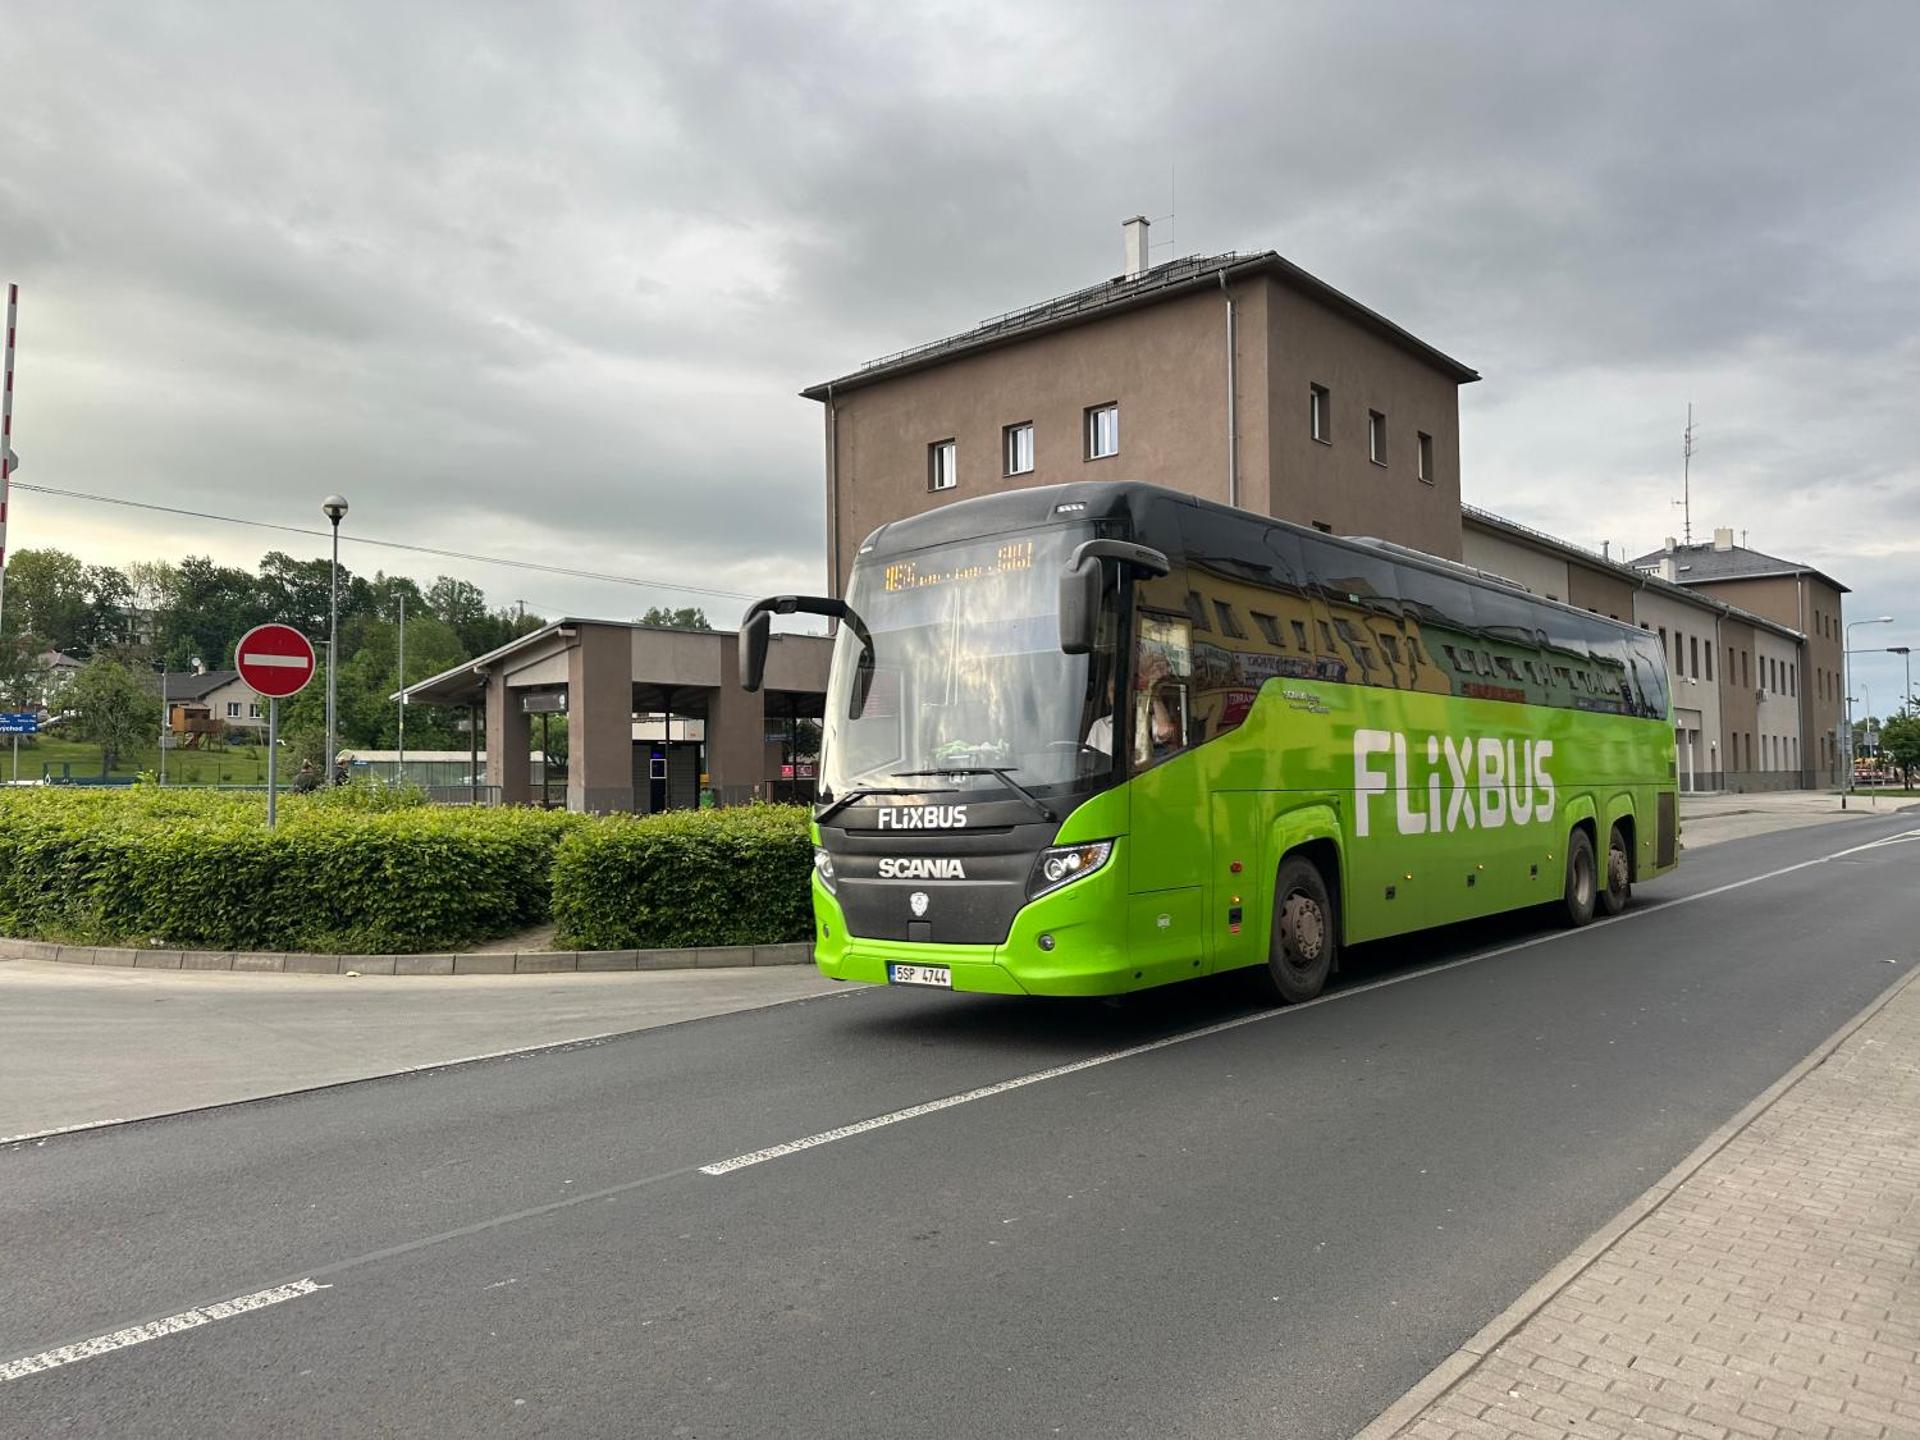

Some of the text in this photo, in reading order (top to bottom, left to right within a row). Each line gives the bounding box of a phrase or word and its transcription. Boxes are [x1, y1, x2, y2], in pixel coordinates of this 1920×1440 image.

[879, 858, 966, 879] SCANIA
[896, 966, 947, 983] 5SP 4744
